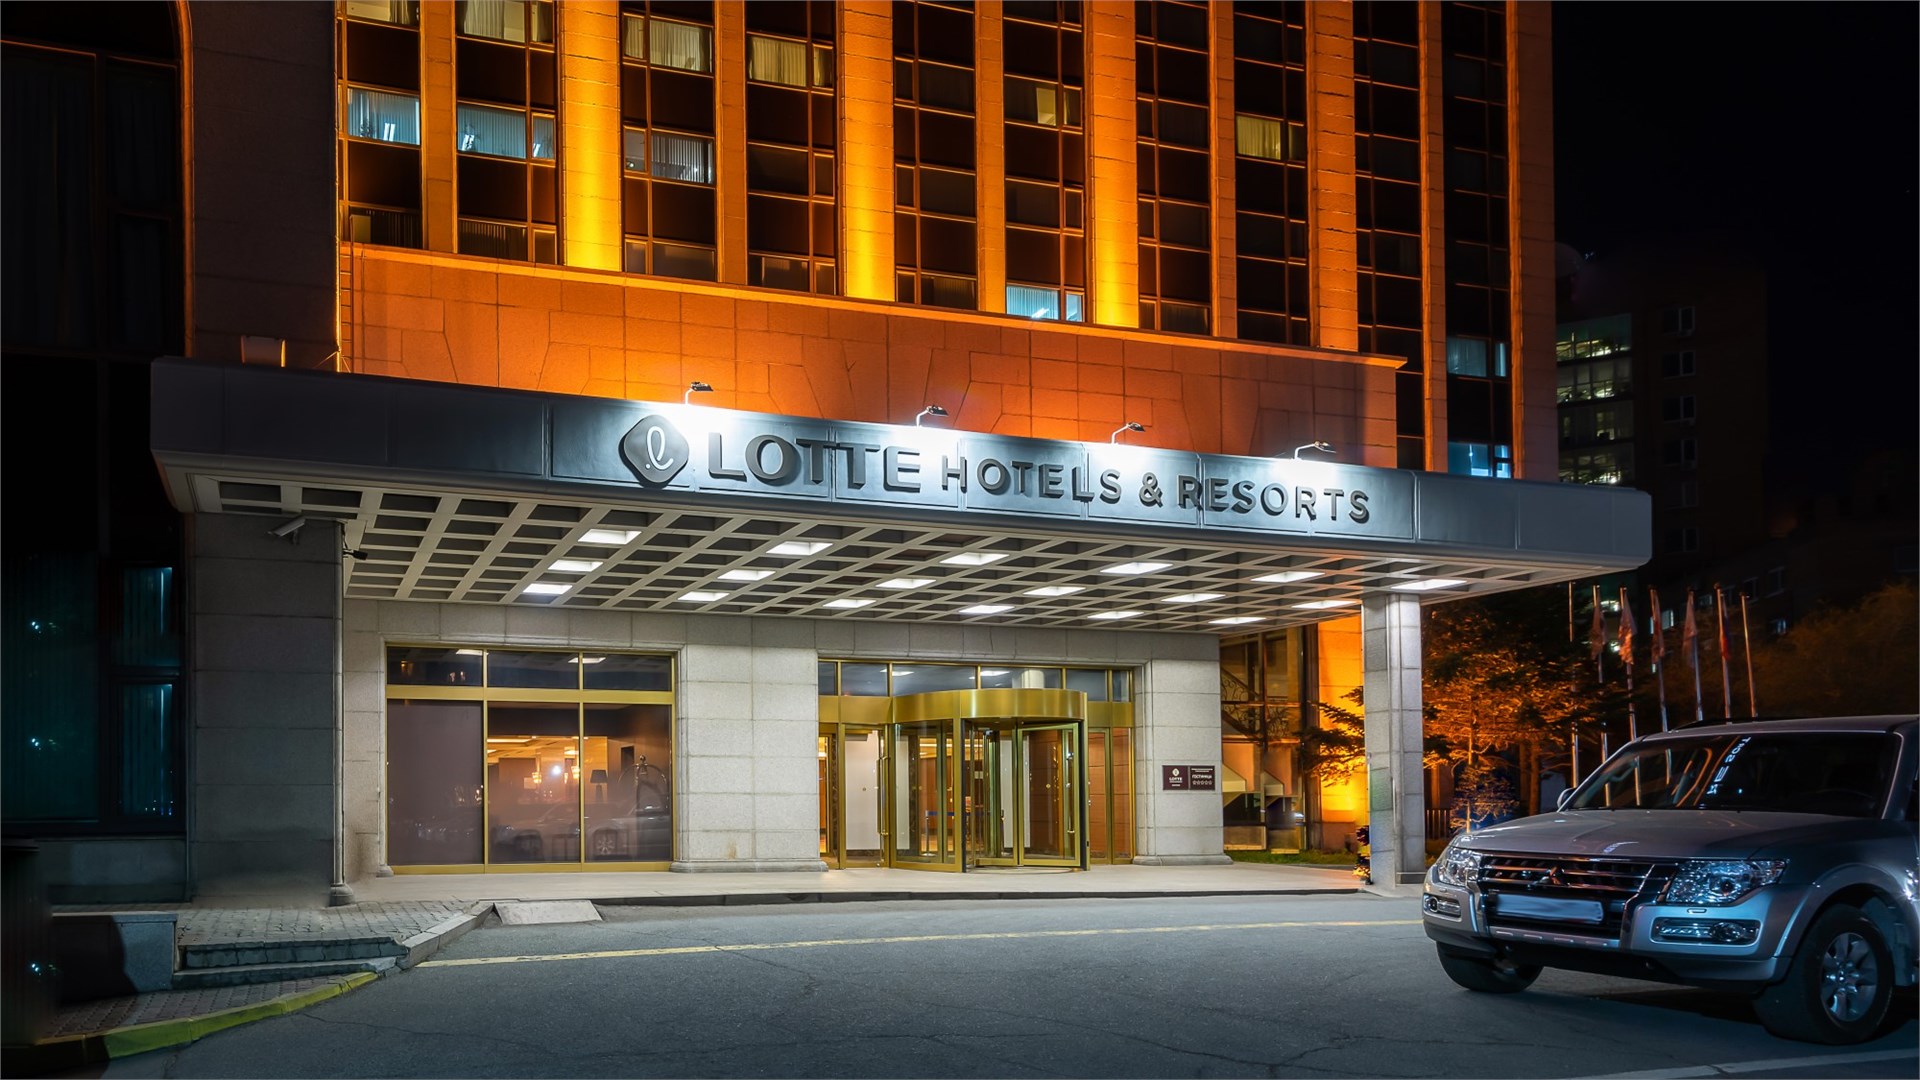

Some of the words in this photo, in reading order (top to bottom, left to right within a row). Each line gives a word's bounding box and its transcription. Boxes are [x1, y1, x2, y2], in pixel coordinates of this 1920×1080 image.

[708, 431, 922, 493] LOTTE
[941, 455, 1122, 504] HOTELS
[1138, 471, 1164, 507] &
[1177, 474, 1370, 523] RESORTS
